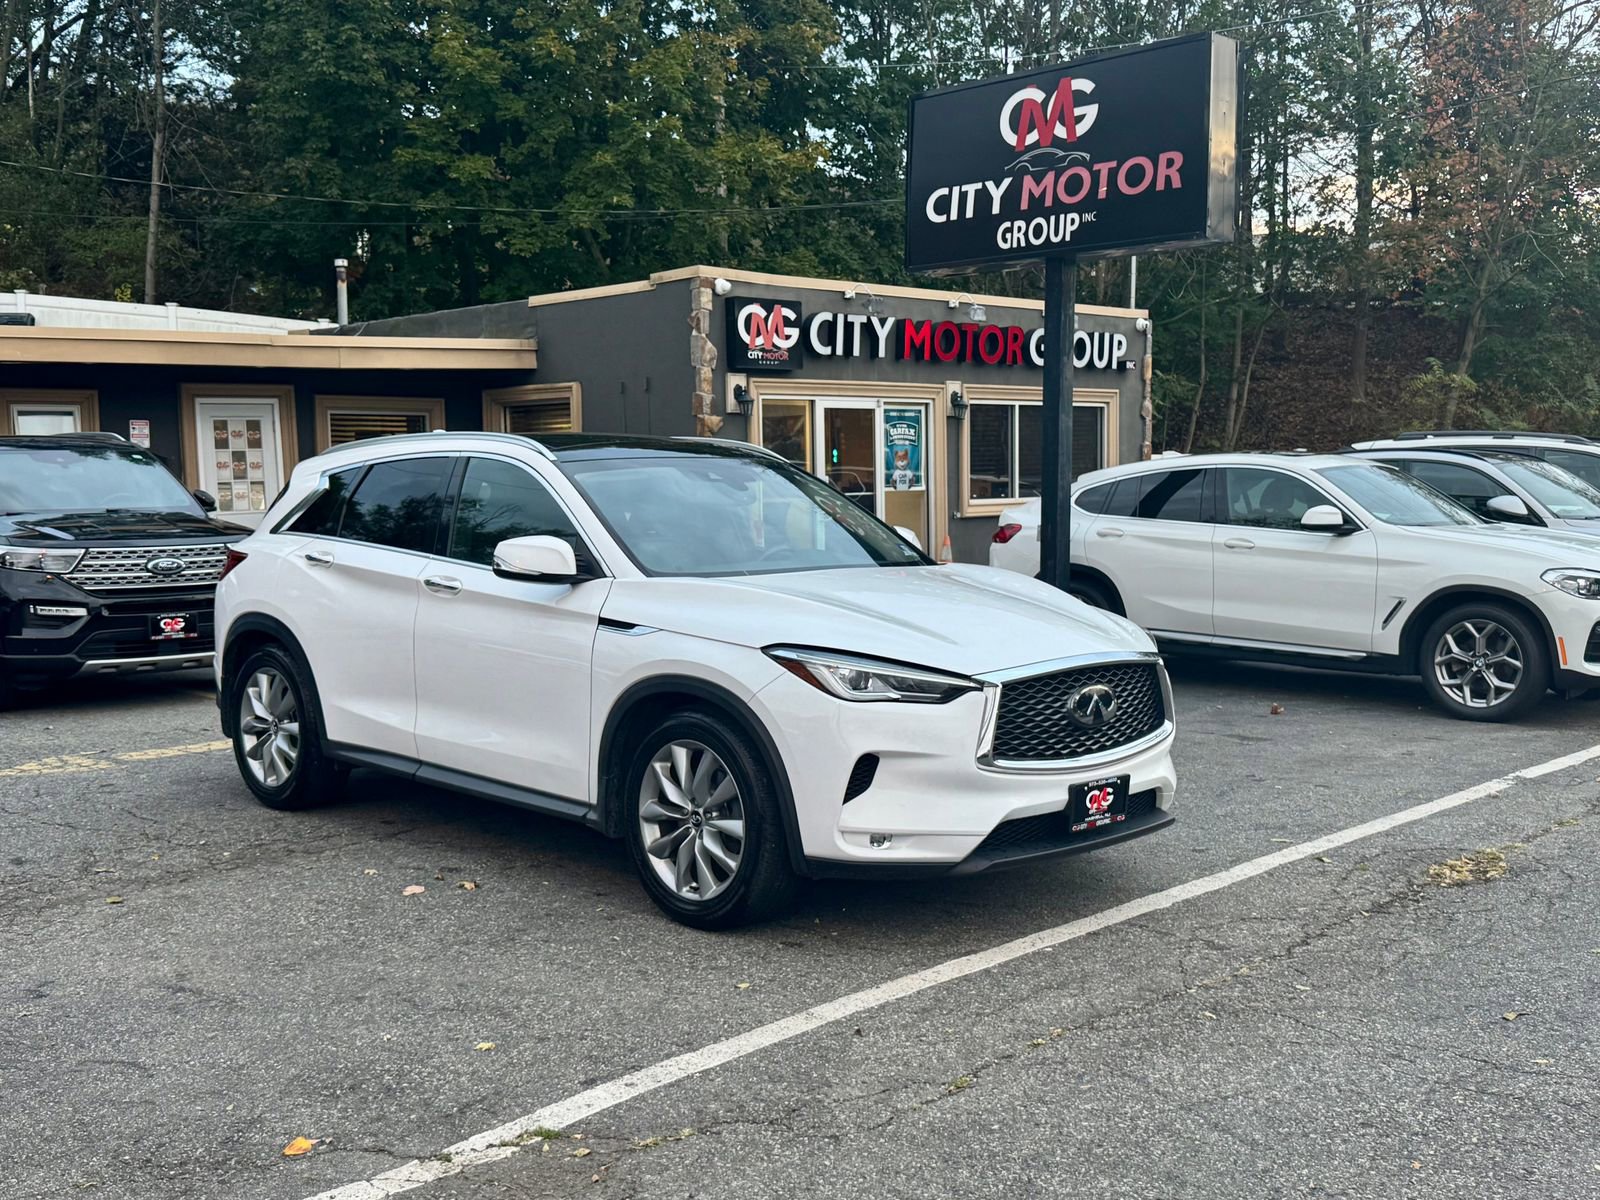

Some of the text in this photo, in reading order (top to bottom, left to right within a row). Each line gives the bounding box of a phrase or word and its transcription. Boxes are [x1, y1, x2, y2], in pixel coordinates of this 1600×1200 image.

[926, 151, 1184, 224] CITY MOTOR
[996, 210, 1097, 250] GROUP INC
[747, 351, 789, 360] CITY MOTOR
[809, 311, 896, 359] CITY
[903, 318, 1025, 366] MOTOR
[1029, 327, 1128, 370] GOUP
[889, 427, 916, 436] CARFAX
